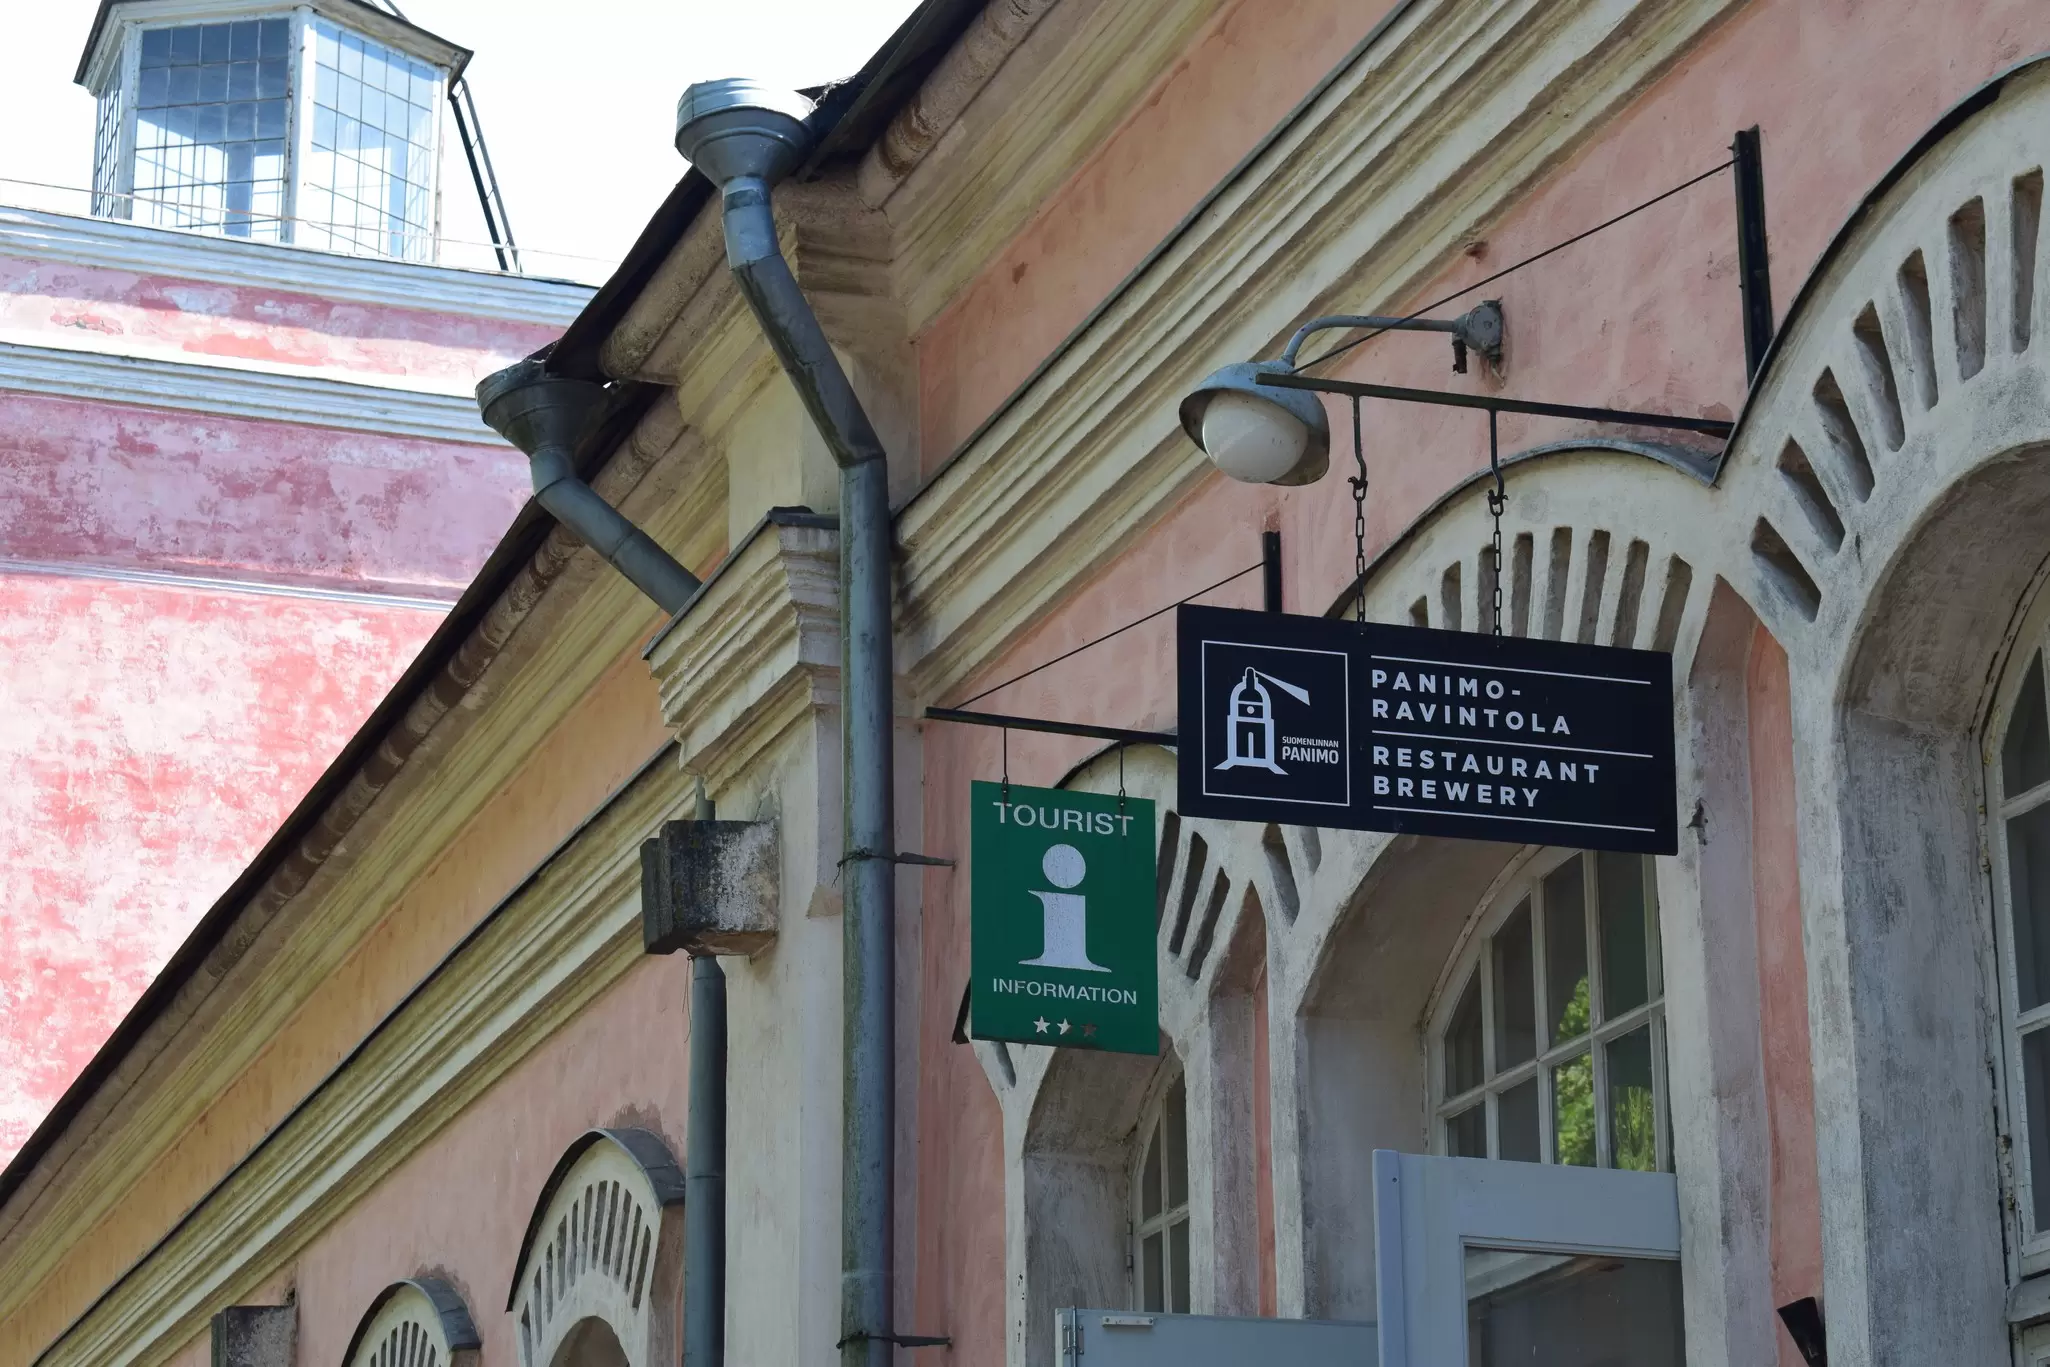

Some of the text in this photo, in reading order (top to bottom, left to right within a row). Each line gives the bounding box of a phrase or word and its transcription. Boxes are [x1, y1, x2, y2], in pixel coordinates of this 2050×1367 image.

[1372, 669, 1521, 700] PANIMO-
[1372, 698, 1571, 735] RAVINTOLA
[1282, 736, 1339, 748] SUOMENLINNAN
[1282, 746, 1339, 764] PANIMO
[1373, 745, 1599, 784] RESTAURANT
[1373, 775, 1540, 807] BREWERY
[993, 801, 1133, 836] TOURIST
[993, 978, 1137, 1004] INFORMATION
